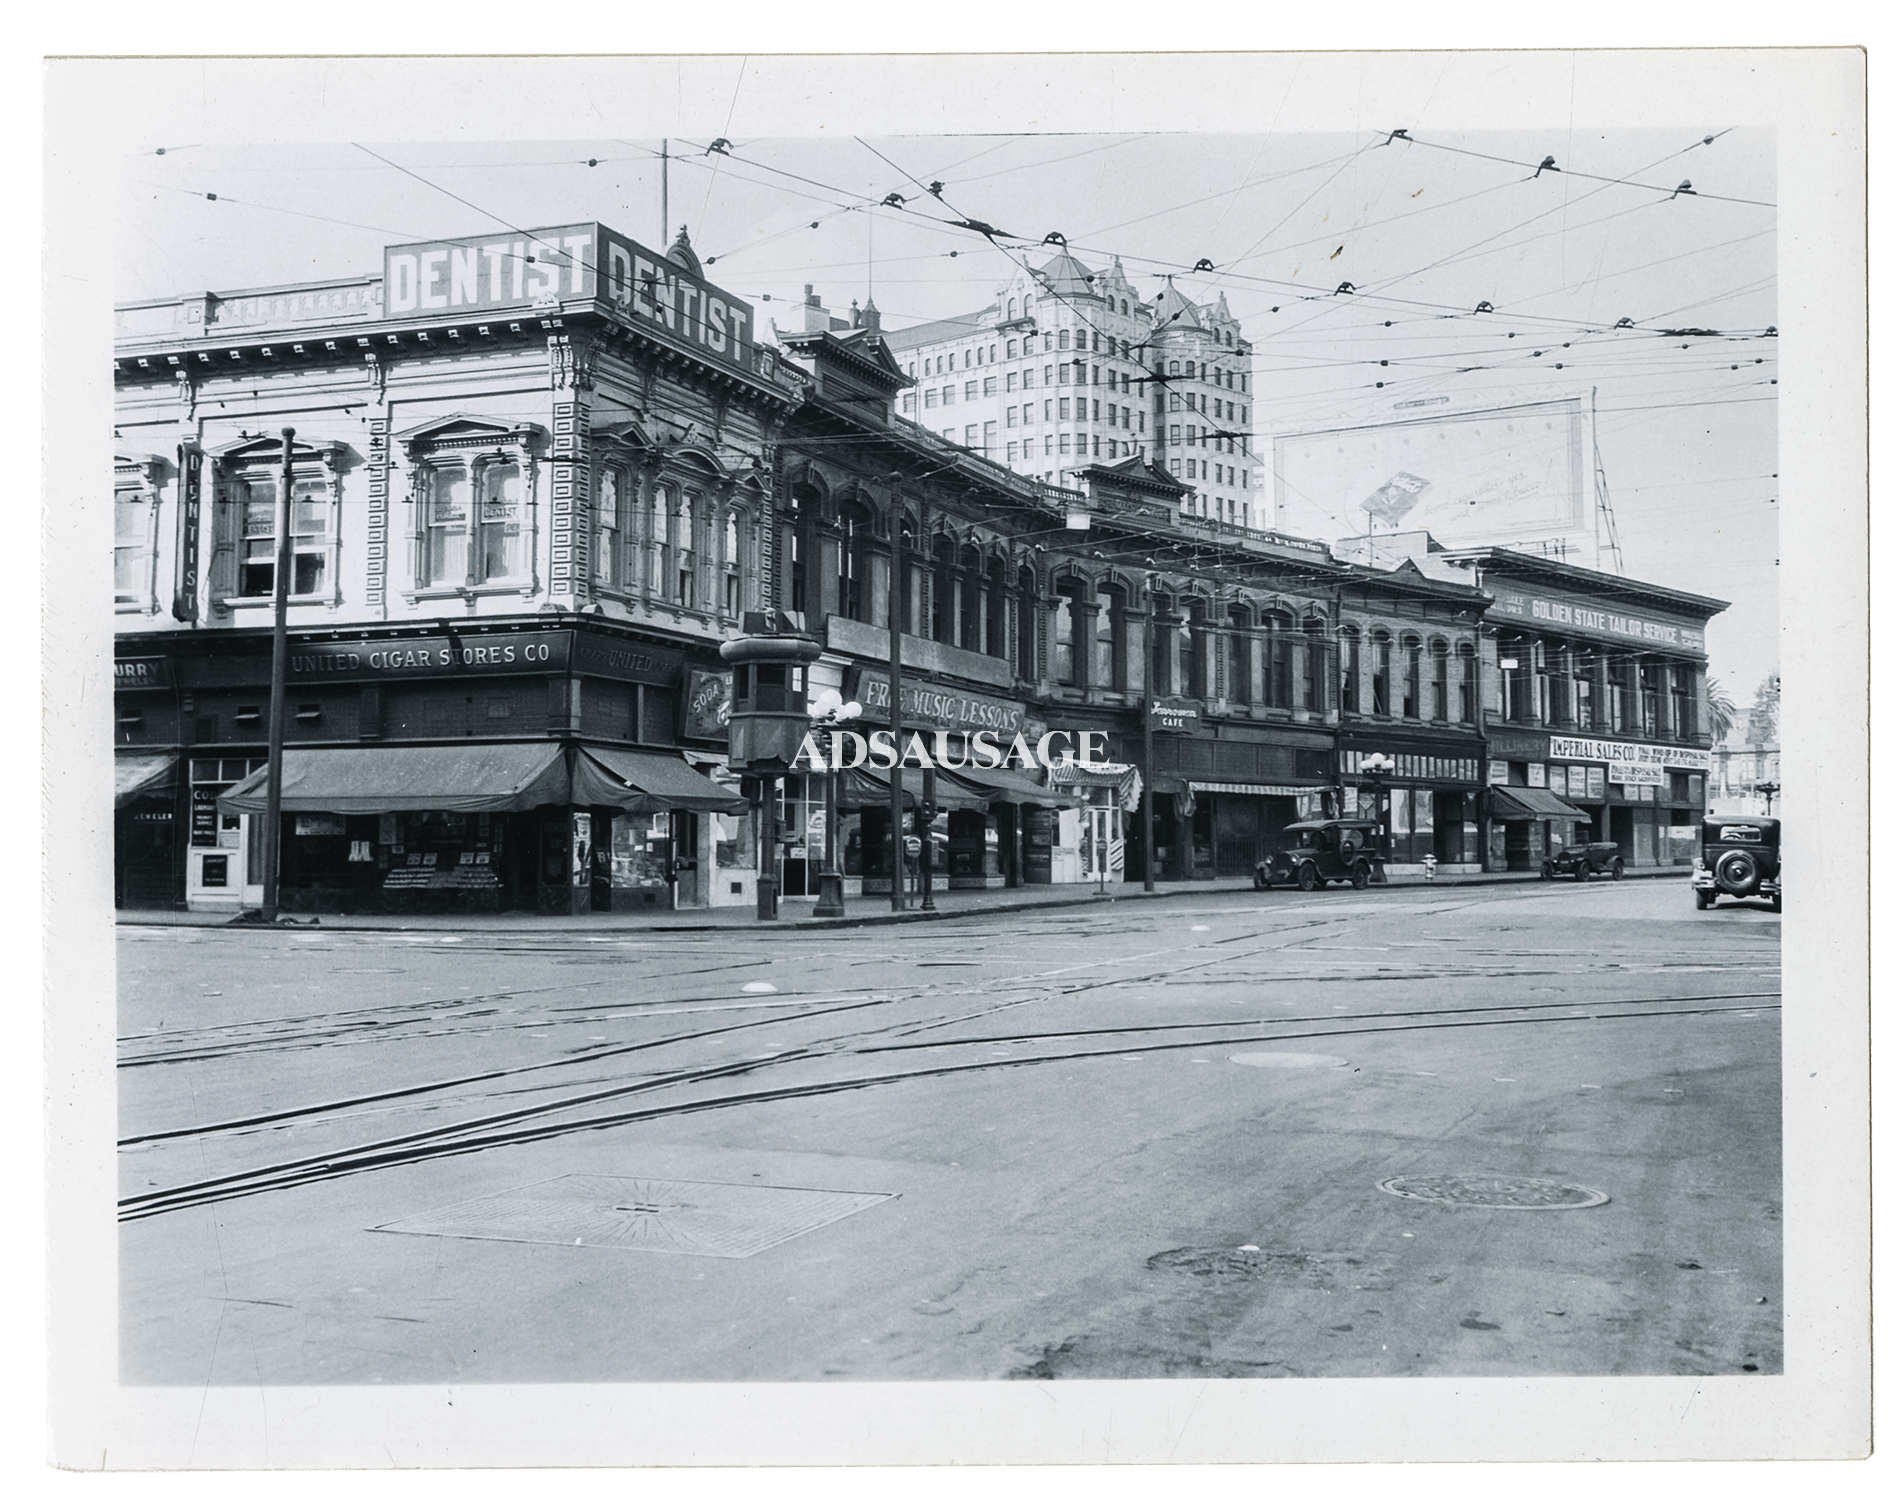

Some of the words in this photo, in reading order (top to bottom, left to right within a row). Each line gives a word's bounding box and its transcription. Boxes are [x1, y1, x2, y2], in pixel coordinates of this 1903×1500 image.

[390, 234, 591, 313] DENTIST
[609, 241, 746, 361] DENTIST
[185, 454, 200, 609] DENTIST
[1532, 600, 1573, 624] GOLDEN
[1574, 609, 1606, 630] STATE
[1608, 615, 1642, 637] TAILOR
[1643, 622, 1677, 643] SERVICE
[291, 653, 360, 672] UNITED
[369, 650, 432, 668] CIGAR
[439, 645, 515, 666] STORES
[524, 644, 550, 661] CO
[608, 650, 652, 671] UNITED
[693, 683, 719, 713] SODA
[865, 680, 907, 710] FRE
[909, 690, 956, 719] MUSIC
[959, 698, 1019, 732] LESSONS
[1162, 717, 1183, 727] CAFE
[1553, 739, 1594, 758] IMPERIAL
[1596, 742, 1622, 761] SALES
